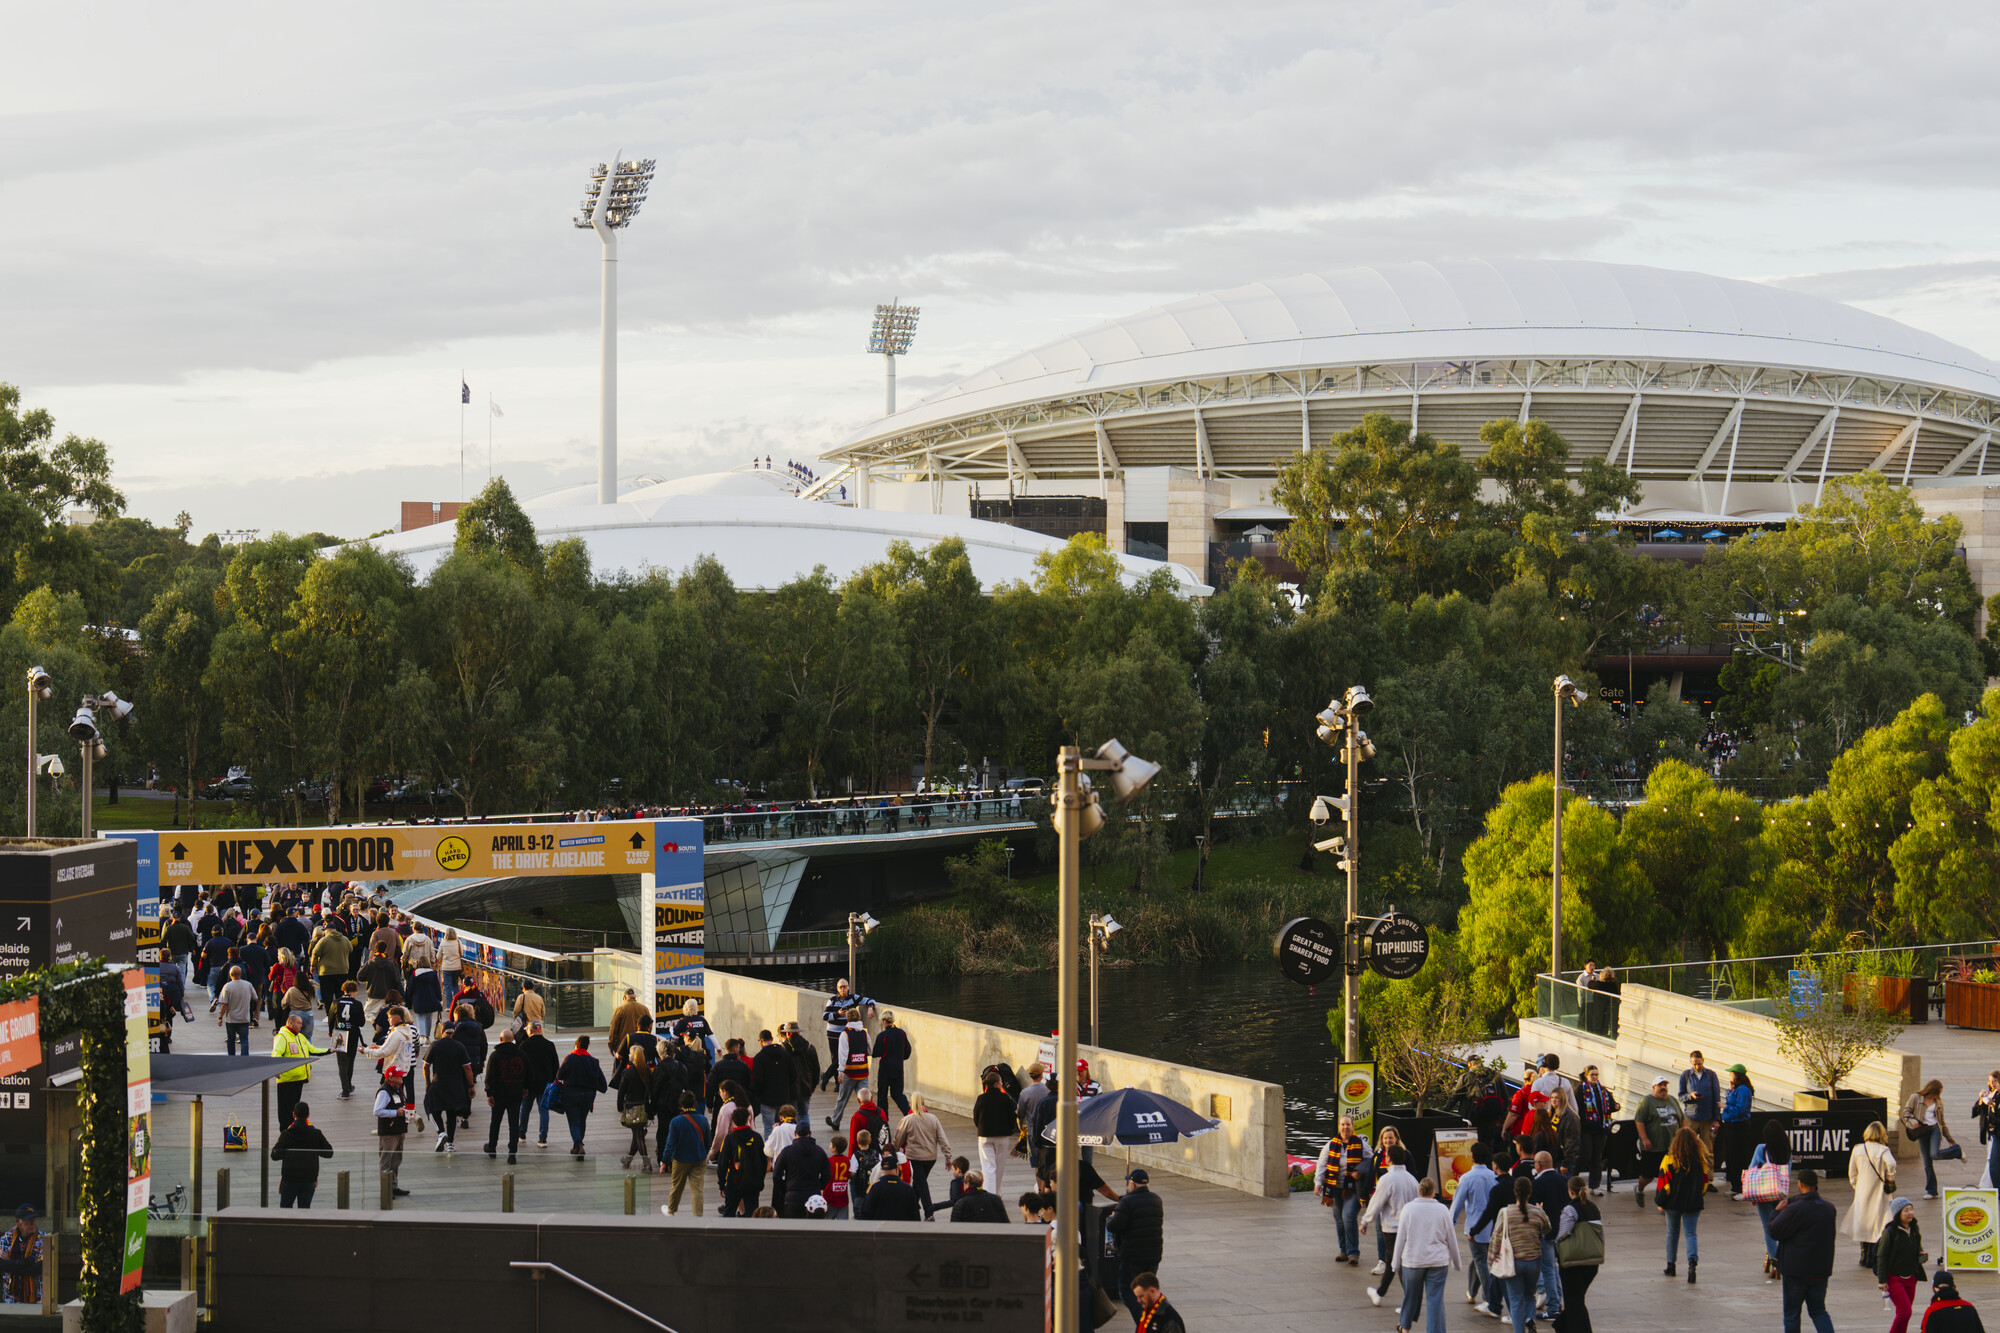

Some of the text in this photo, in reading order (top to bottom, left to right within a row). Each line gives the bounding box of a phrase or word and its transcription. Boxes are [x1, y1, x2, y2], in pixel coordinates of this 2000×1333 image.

[1600, 687, 1624, 697] Gate
[492, 834, 554, 851] APRIL 9-12
[218, 837, 394, 874] NEXT DOOR
[402, 849, 431, 857] HOSTED BY
[442, 853, 467, 863] RATED
[492, 851, 605, 869] THE DRIVE ADELAIDE
[655, 887, 704, 901] GATHER
[655, 906, 704, 927] ROUND
[1380, 918, 1419, 935] MALT SHOVEL
[655, 930, 704, 944] GATHER
[56, 941, 72, 953] Adelaide
[1292, 934, 1333, 956] GREAT BEERS
[1375, 940, 1425, 955] TAPHOUSE
[655, 950, 704, 971] ROUND
[1289, 943, 1330, 966] SHARED FOOD
[656, 972, 704, 986] GATHER
[342, 1004, 350, 1022] 4
[10, 1012, 36, 1041] GROUND
[55, 1041, 74, 1055] Elder Park
[1133, 1111, 1167, 1124] m
[1346, 1106, 1360, 1115] PIE
[1149, 1132, 1162, 1140] m
[1821, 1129, 1850, 1151] AVE
[835, 1162, 848, 1180] 12
[1948, 1228, 1995, 1245] PIE FLOATER
[906, 1295, 1024, 1308] Riverbank Car Park
[906, 1309, 939, 1322] Entry
[942, 1310, 960, 1321] via
